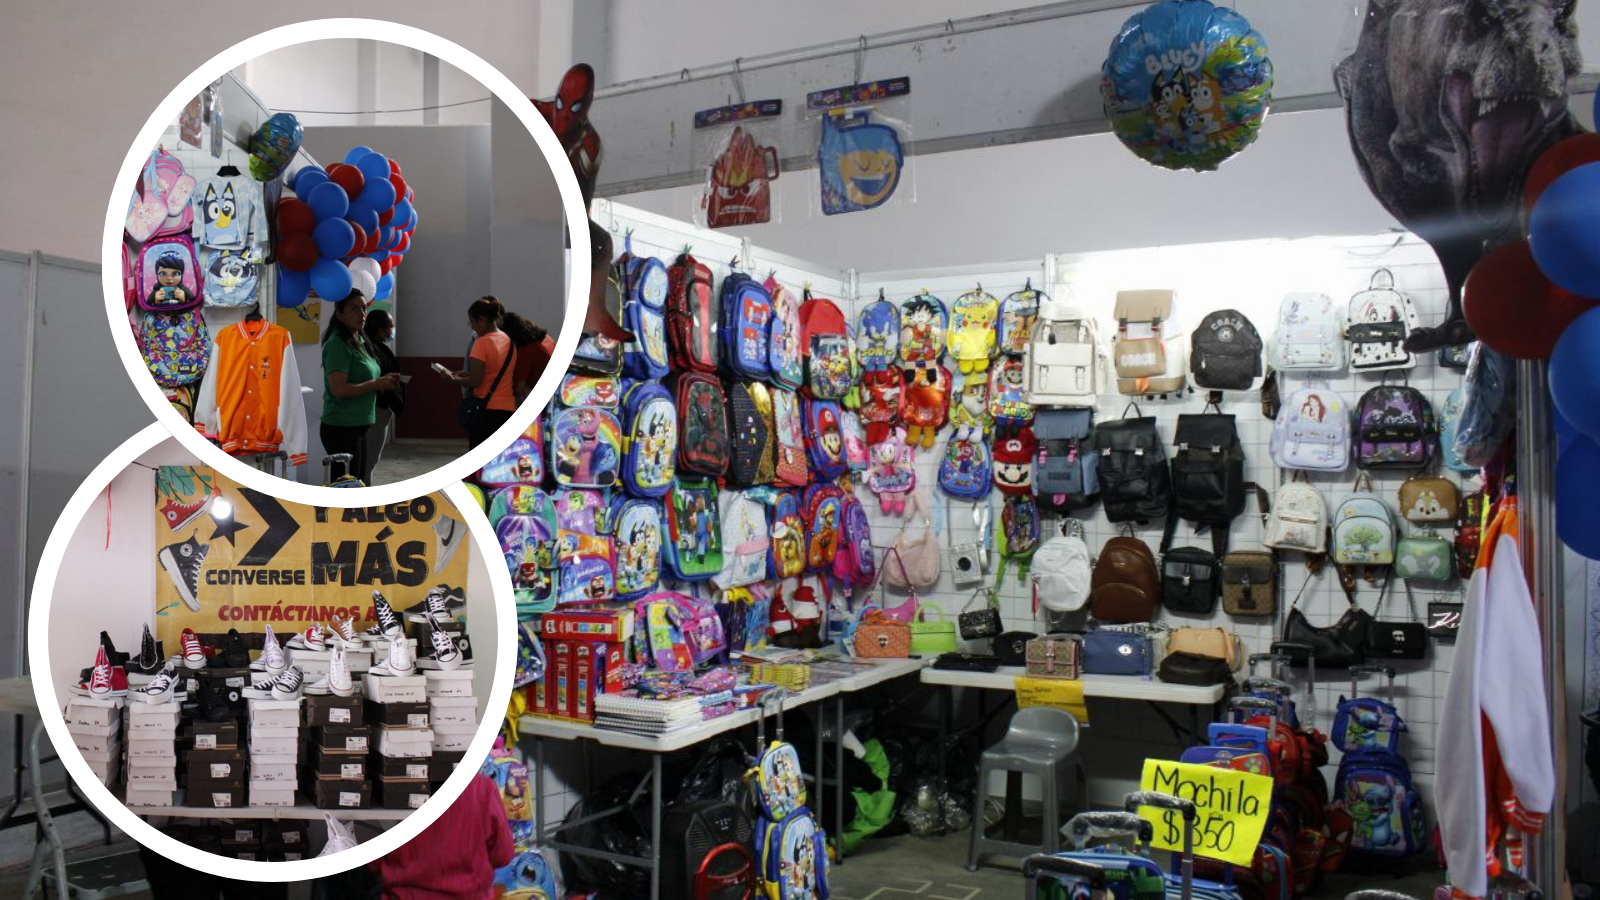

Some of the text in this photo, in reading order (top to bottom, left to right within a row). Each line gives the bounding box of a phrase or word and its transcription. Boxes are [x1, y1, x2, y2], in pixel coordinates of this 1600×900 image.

[1144, 41, 1206, 75] BLUEY
[1210, 317, 1244, 332] COACH
[341, 495, 438, 525] ALGO
[311, 525, 429, 587] MÁS
[205, 569, 305, 585] CONVERSE
[218, 599, 361, 622] CONTÁCTANOS
[1153, 764, 1260, 817] Mochila
